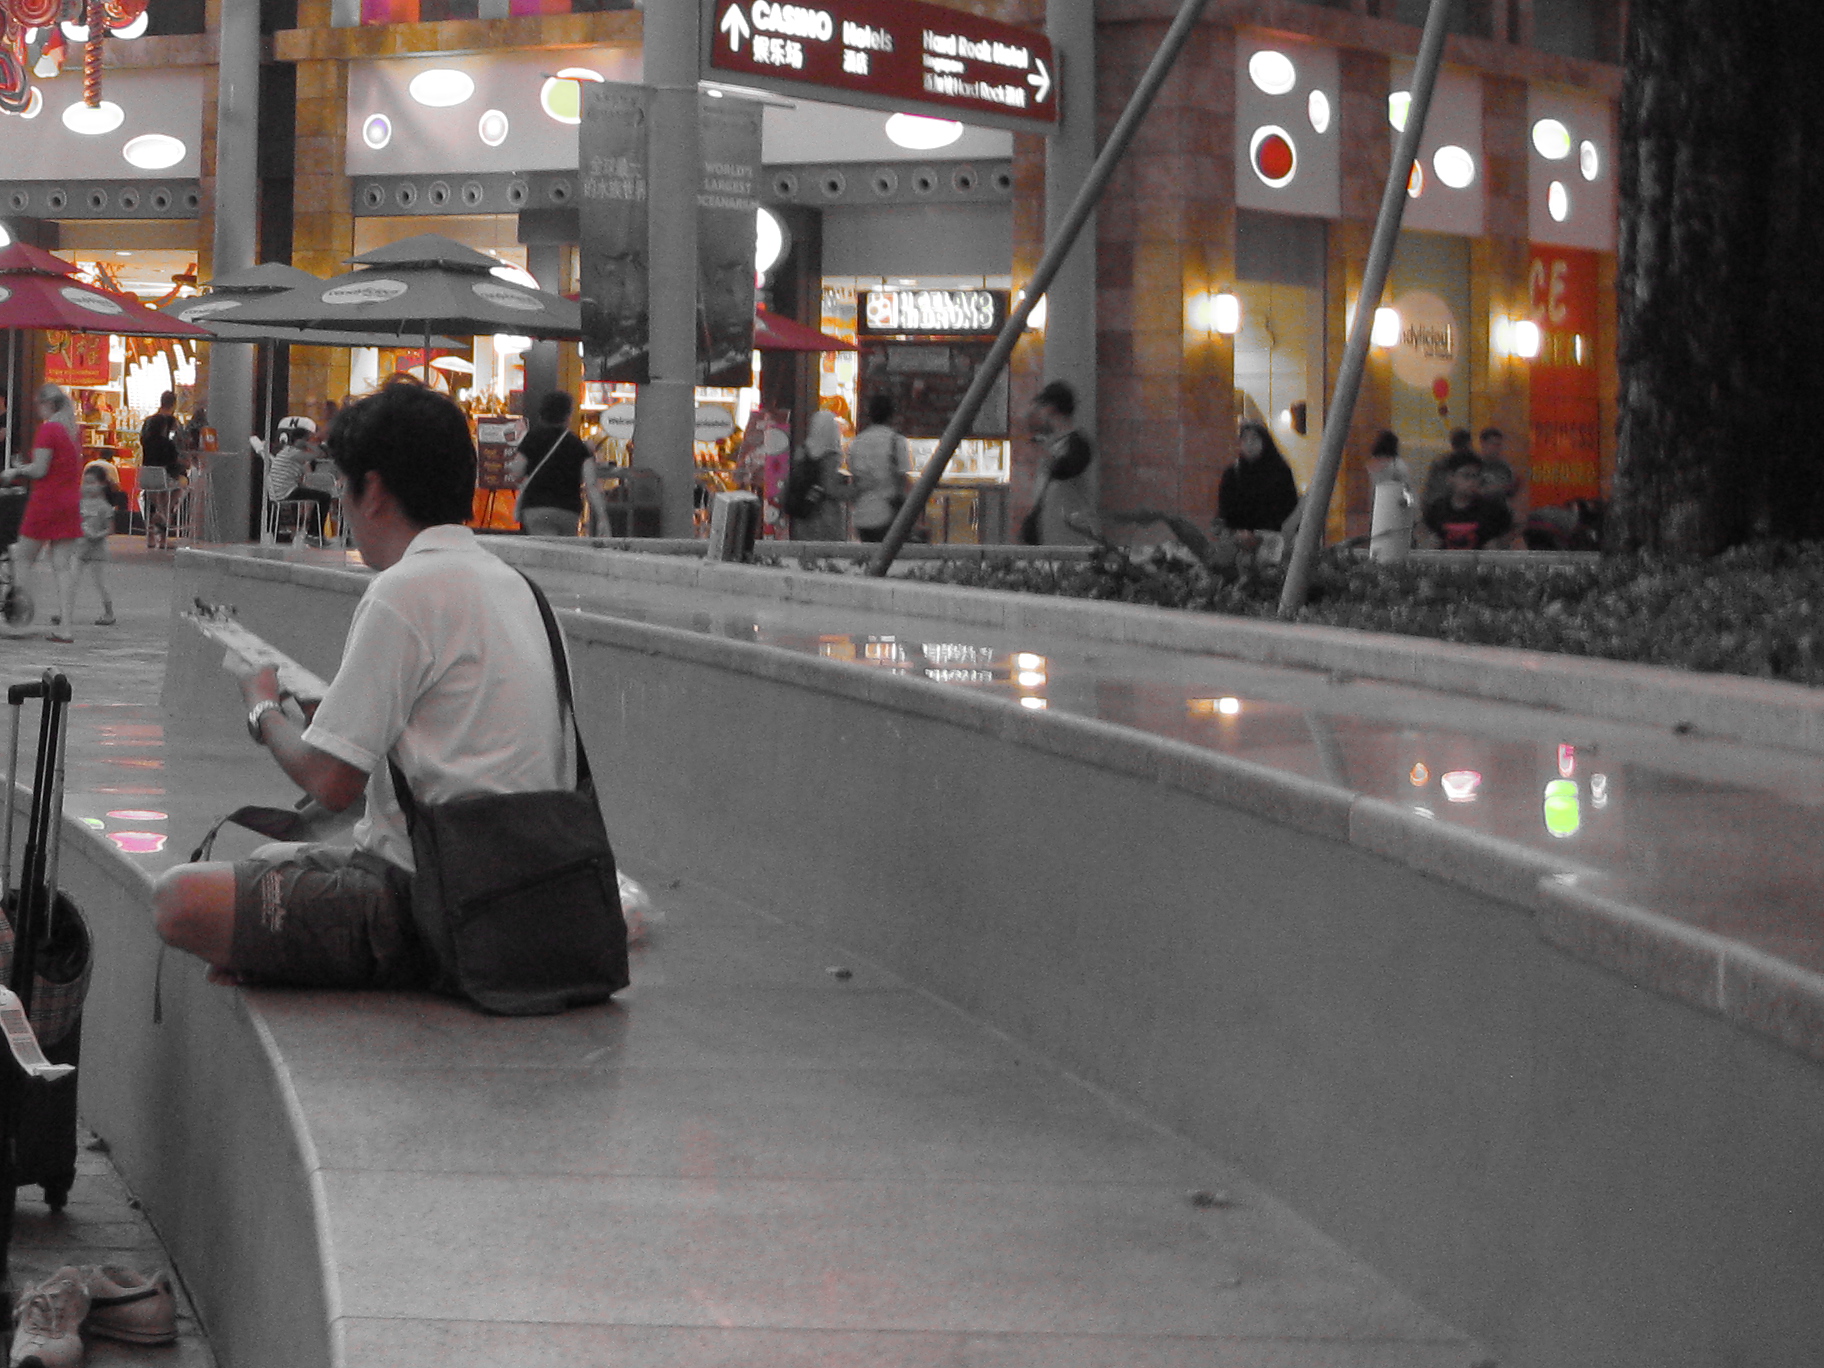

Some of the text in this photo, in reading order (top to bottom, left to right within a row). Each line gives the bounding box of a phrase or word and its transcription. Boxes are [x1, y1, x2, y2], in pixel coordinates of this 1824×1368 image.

[751, 0, 833, 41] CASINO
[842, 20, 893, 52] Hotels
[923, 29, 1029, 69] Hard Rock Hotel
